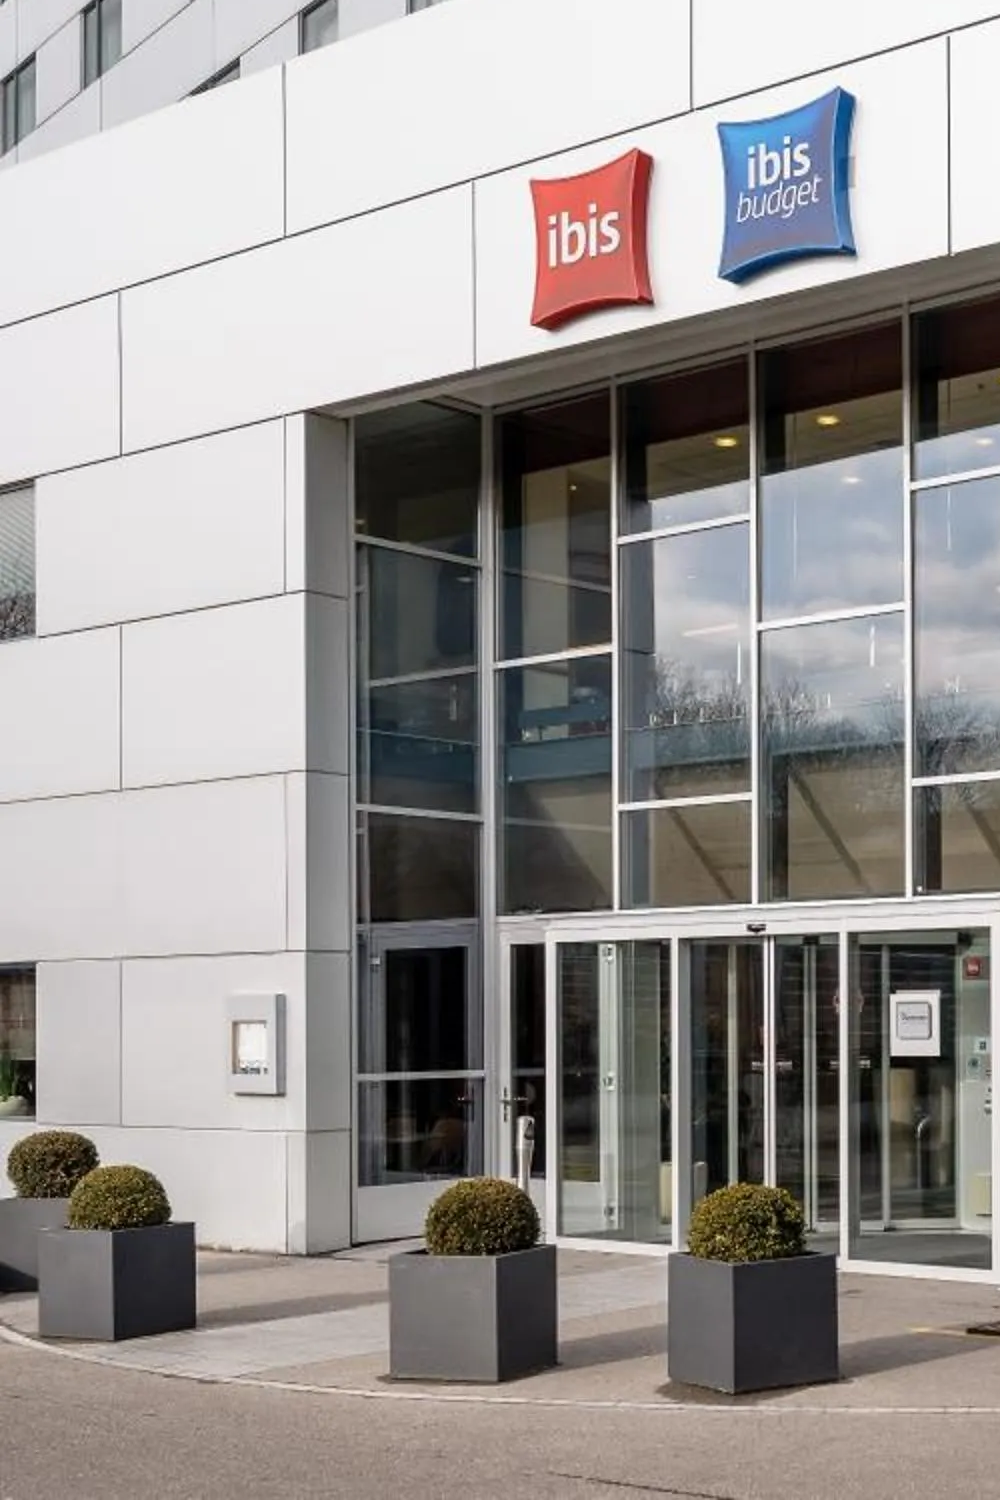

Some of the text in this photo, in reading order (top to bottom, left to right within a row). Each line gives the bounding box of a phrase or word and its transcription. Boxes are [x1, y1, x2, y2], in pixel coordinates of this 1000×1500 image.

[747, 135, 811, 190] ibis
[736, 174, 822, 223] budget
[548, 203, 620, 267] ibis
